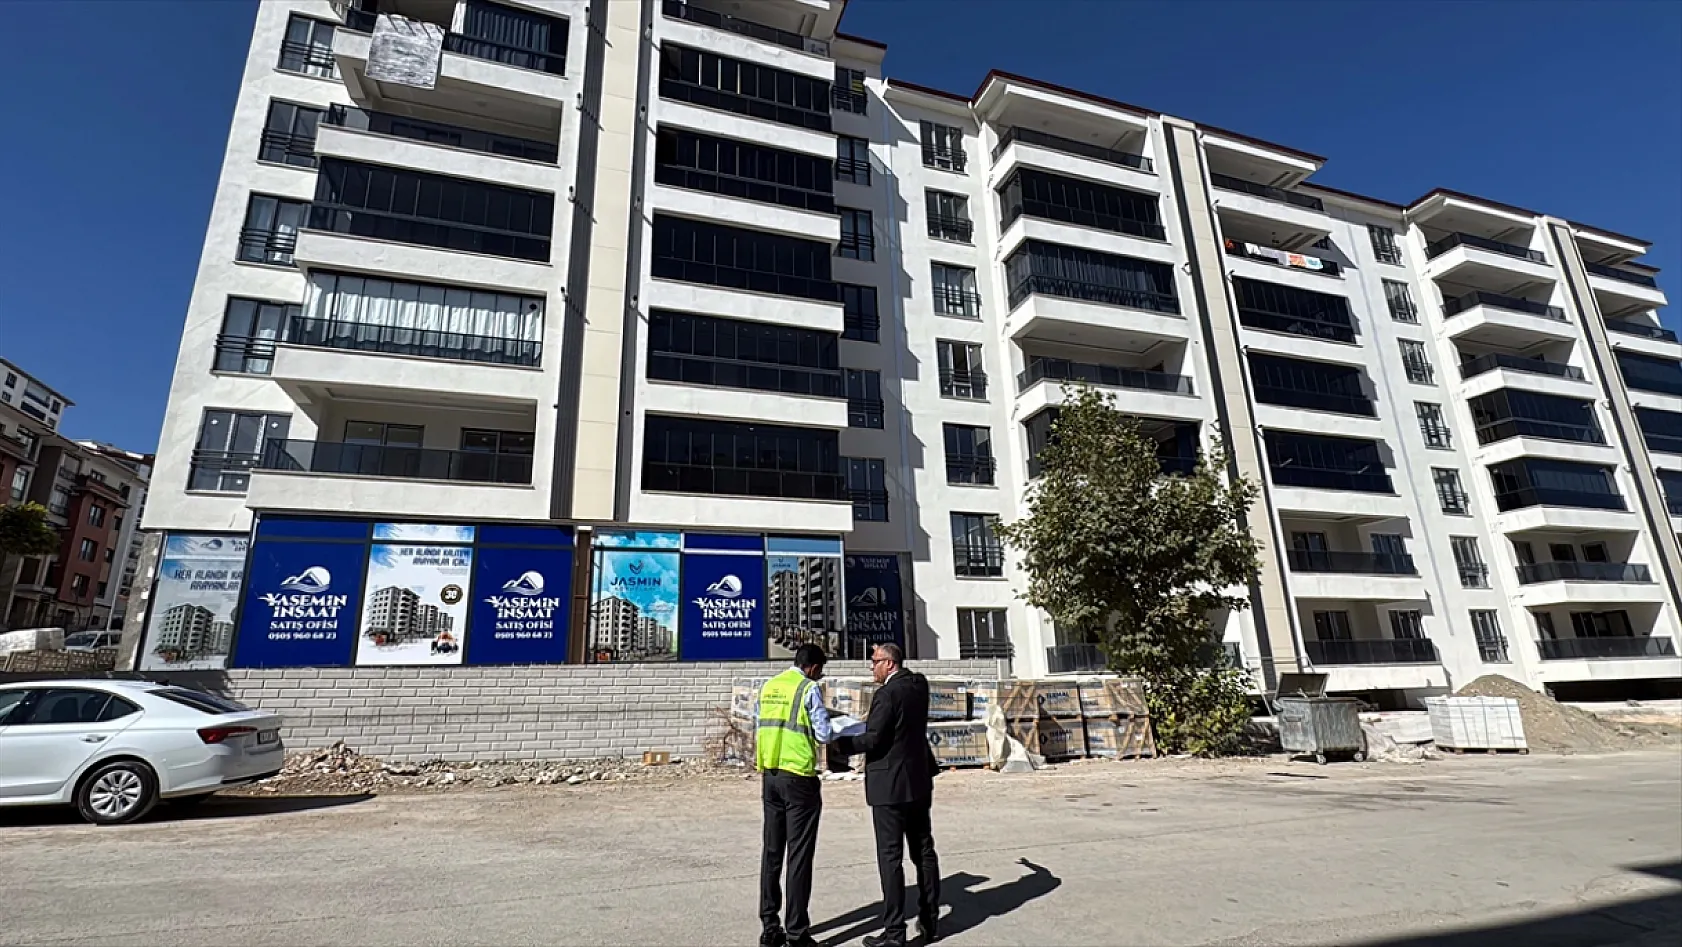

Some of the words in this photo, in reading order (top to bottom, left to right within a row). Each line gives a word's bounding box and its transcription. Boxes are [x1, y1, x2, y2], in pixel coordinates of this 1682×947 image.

[611, 577, 661, 586] JASMIN
[258, 593, 347, 607] YASEMİN
[483, 595, 560, 608] YASEMİN
[692, 597, 756, 609] YASEMİN
[270, 620, 304, 631] SATIŞ
[306, 619, 338, 629] OFİSİ
[496, 621, 525, 631] SATIŞ
[526, 620, 553, 629] OFİSİ
[268, 632, 291, 640] 0505
[293, 632, 311, 640] 960
